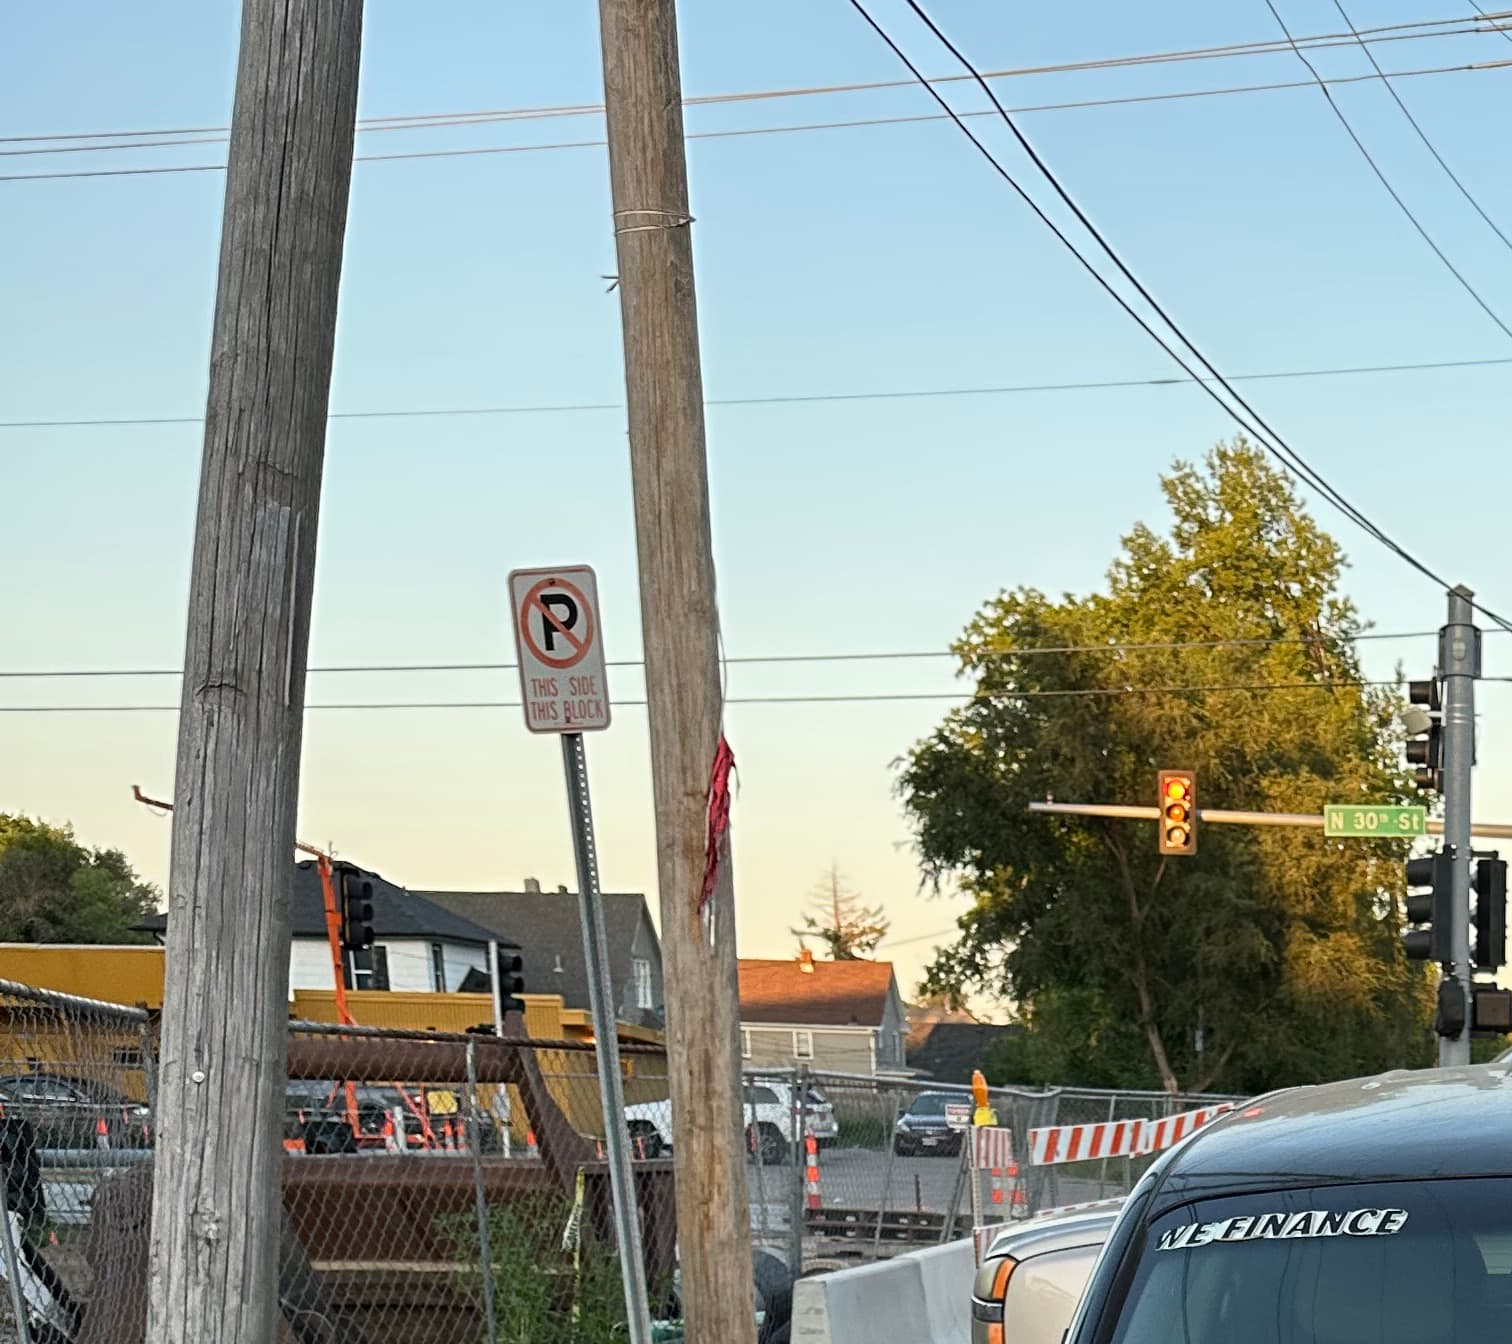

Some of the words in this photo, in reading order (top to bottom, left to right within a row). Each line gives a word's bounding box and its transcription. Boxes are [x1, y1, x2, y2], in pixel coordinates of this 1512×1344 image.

[531, 678, 559, 698] THIS
[569, 676, 598, 697] SIDE
[531, 701, 559, 721] THIS
[563, 699, 604, 721] BLOCK
[1330, 812, 1344, 830] N
[1398, 812, 1420, 831] St
[1157, 1223, 1213, 1250] WE
[1221, 1209, 1408, 1240] FINANCE
